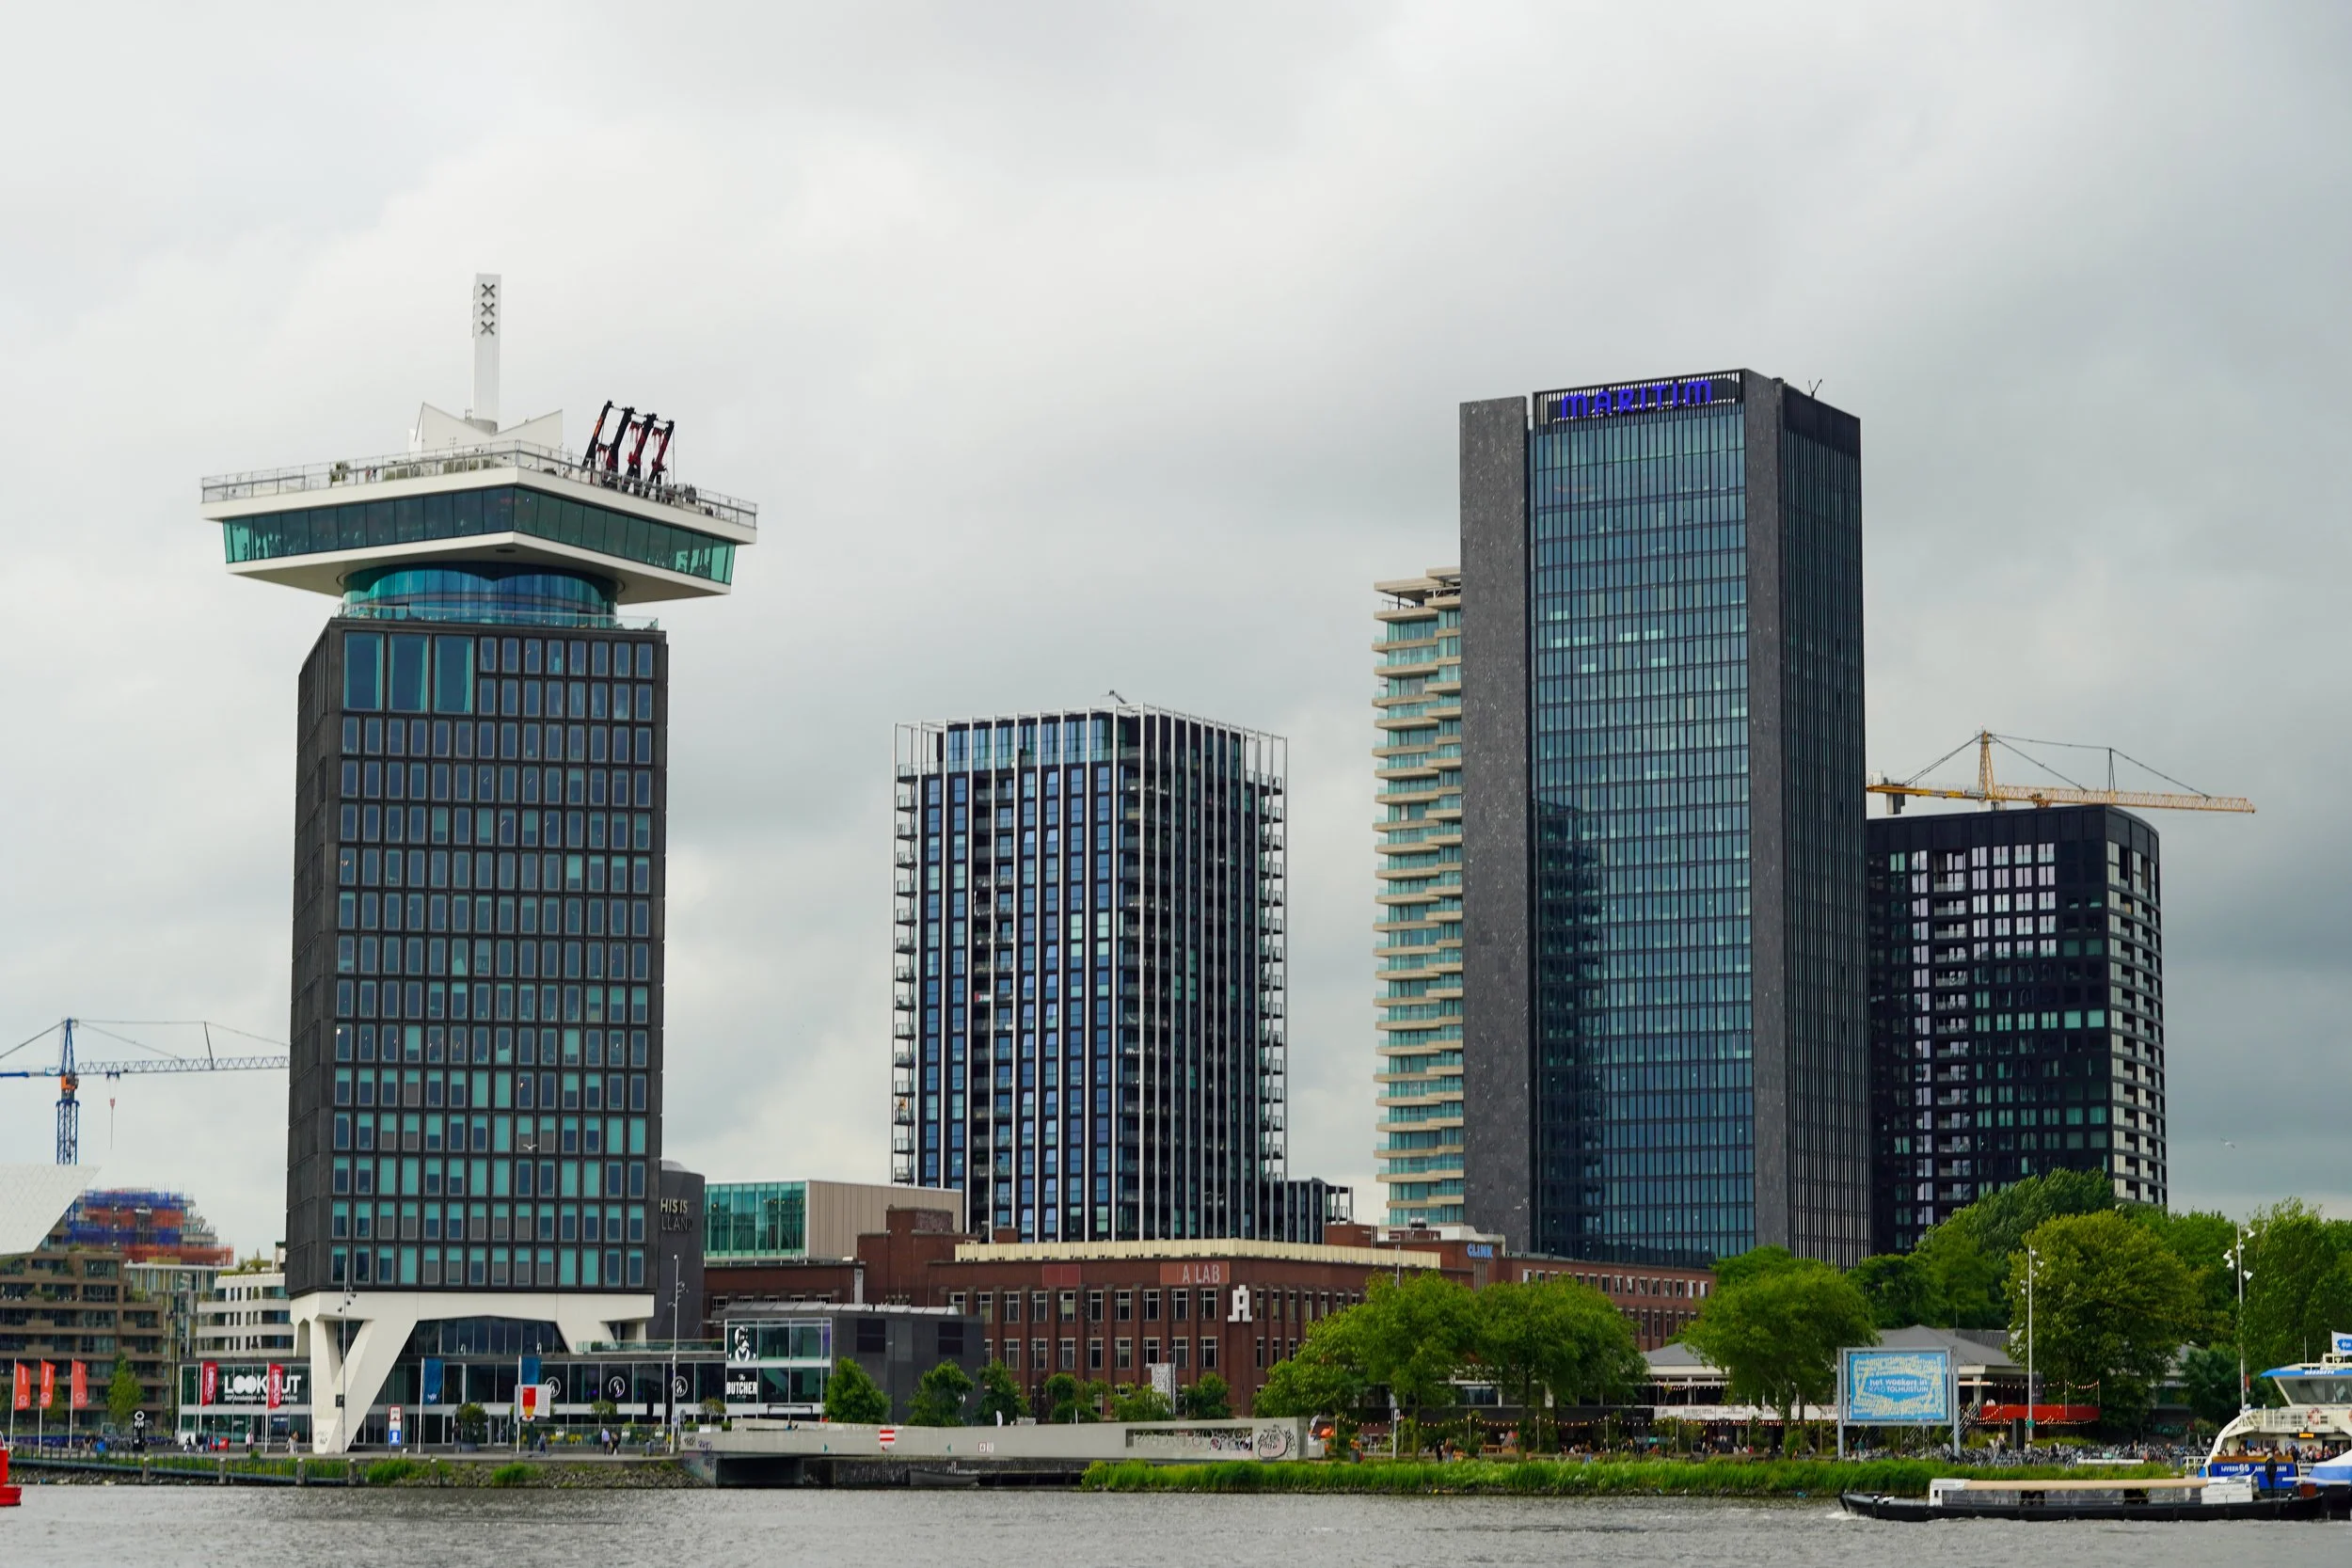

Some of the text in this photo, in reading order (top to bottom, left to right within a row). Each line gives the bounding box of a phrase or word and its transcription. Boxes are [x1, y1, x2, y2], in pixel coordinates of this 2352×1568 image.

[1182, 1263, 1220, 1284] A LAB
[224, 1374, 301, 1394] LOOKUT
[726, 1381, 757, 1395] BUTCHER
